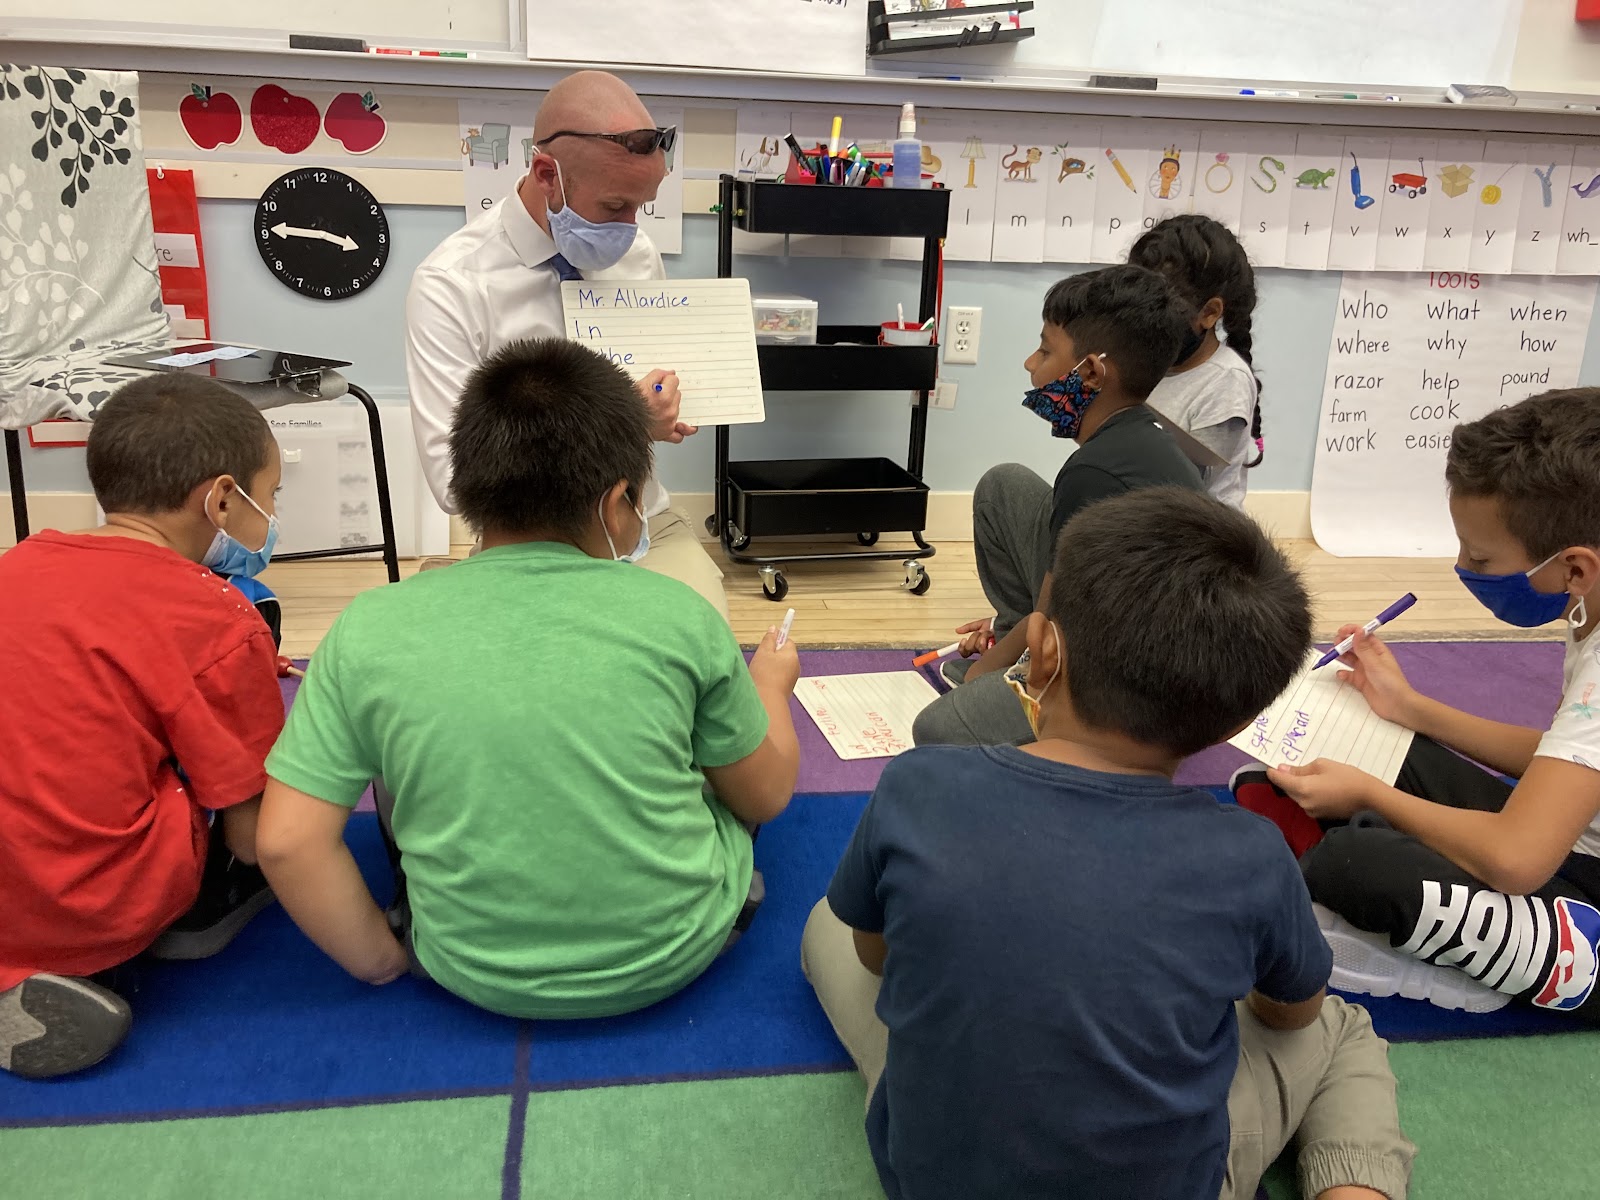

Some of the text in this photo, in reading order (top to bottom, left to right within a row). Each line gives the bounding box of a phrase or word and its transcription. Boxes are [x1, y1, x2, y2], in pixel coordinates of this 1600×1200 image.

[313, 172, 327, 182] 12
[284, 178, 296, 189] 11
[346, 182, 353, 192] 1
[263, 201, 277, 211] 10
[370, 205, 378, 215] 2
[1011, 214, 1027, 227] m
[1061, 214, 1072, 227] n
[1108, 217, 1121, 235] p
[1259, 220, 1266, 234] s
[1303, 221, 1310, 235] t
[1350, 226, 1359, 236] v
[1395, 227, 1409, 237] w
[262, 230, 269, 239] 9
[379, 234, 386, 243] 3
[1443, 227, 1452, 239] x
[1485, 229, 1496, 246] y
[1531, 231, 1540, 242] z
[276, 261, 282, 270] 8
[372, 258, 380, 267] 4
[296, 278, 303, 287] 7
[352, 279, 360, 288] 5
[324, 287, 331, 296] 6
[579, 288, 689, 309] Mr. Allardice
[1427, 299, 1480, 320] what
[1510, 301, 1567, 322] when
[1337, 330, 1556, 359] where why how
[1334, 368, 1550, 399] razor help pound
[1329, 399, 1460, 423] farm cook
[1326, 429, 1376, 452] work
[1397, 880, 1551, 995] NBA
